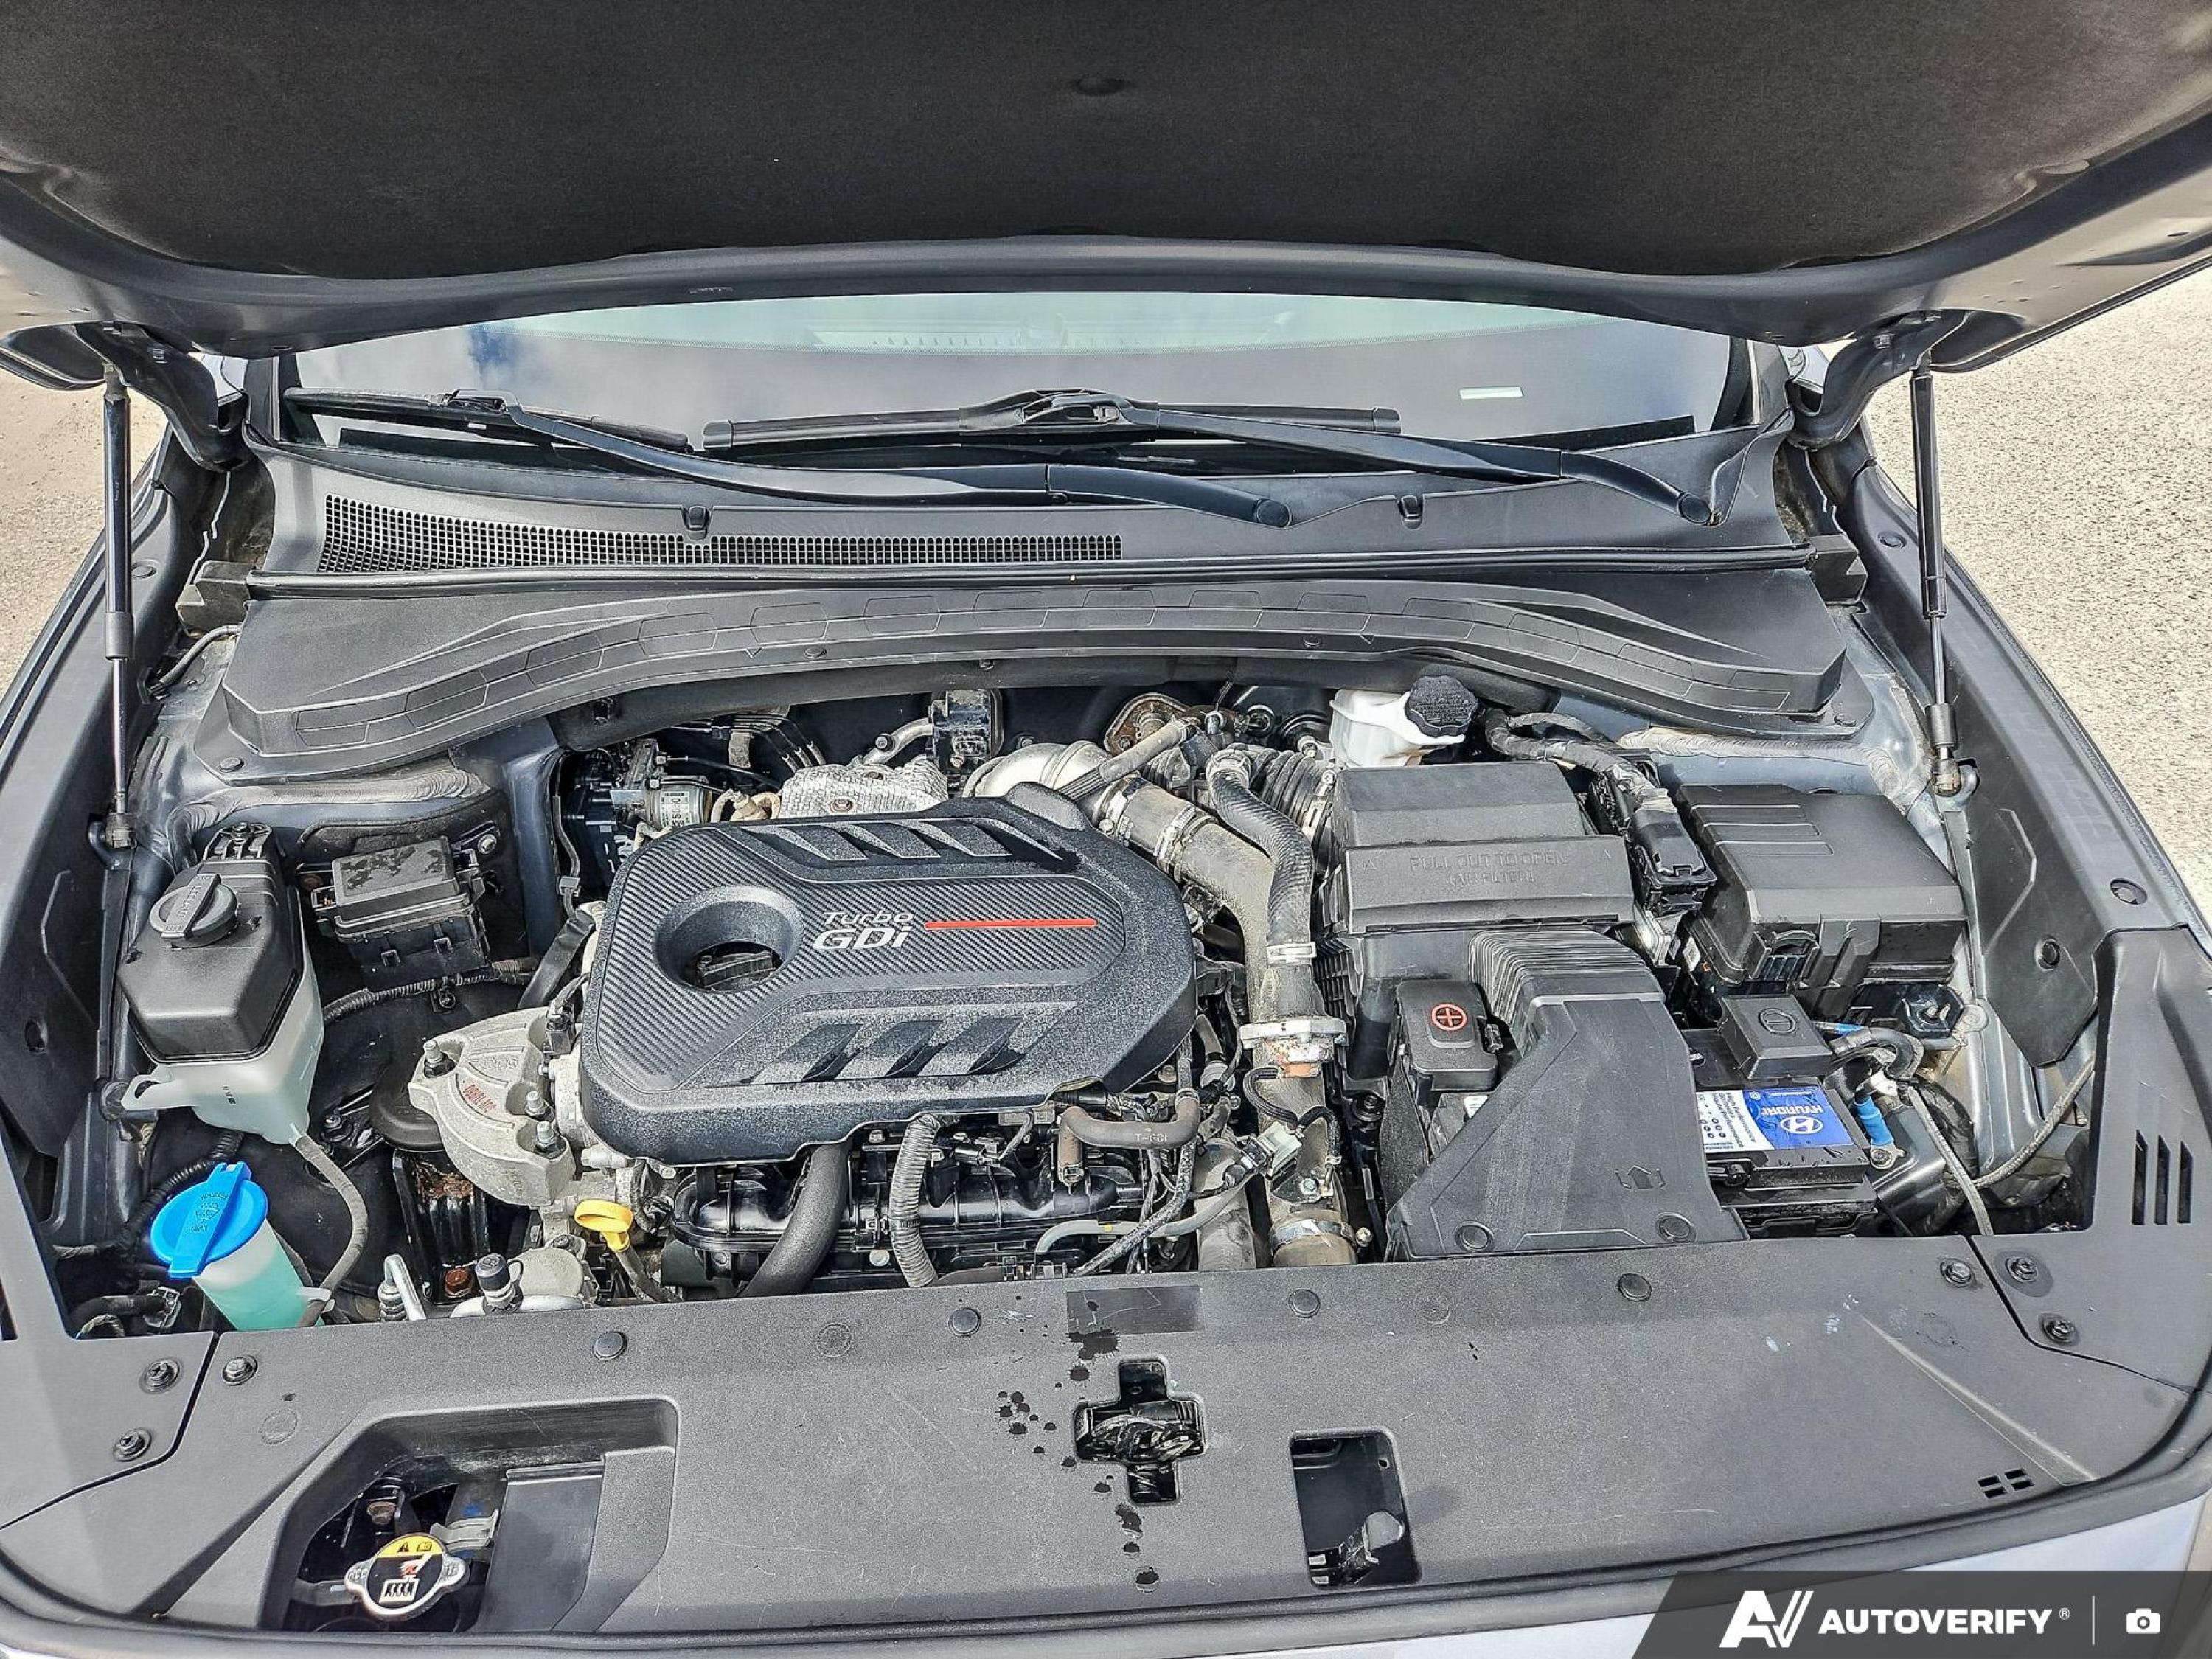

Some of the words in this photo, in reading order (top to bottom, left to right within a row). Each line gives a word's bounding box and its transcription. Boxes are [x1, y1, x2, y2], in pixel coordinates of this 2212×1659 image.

[1410, 856, 1451, 870] PULL
[1457, 853, 1492, 868] OUT
[1496, 852, 1518, 866] TO
[1521, 850, 1568, 866] OPEN
[823, 911, 914, 925] Turbo
[813, 925, 913, 950] GDi
[1761, 1105, 1824, 1116] HYUNDAI
